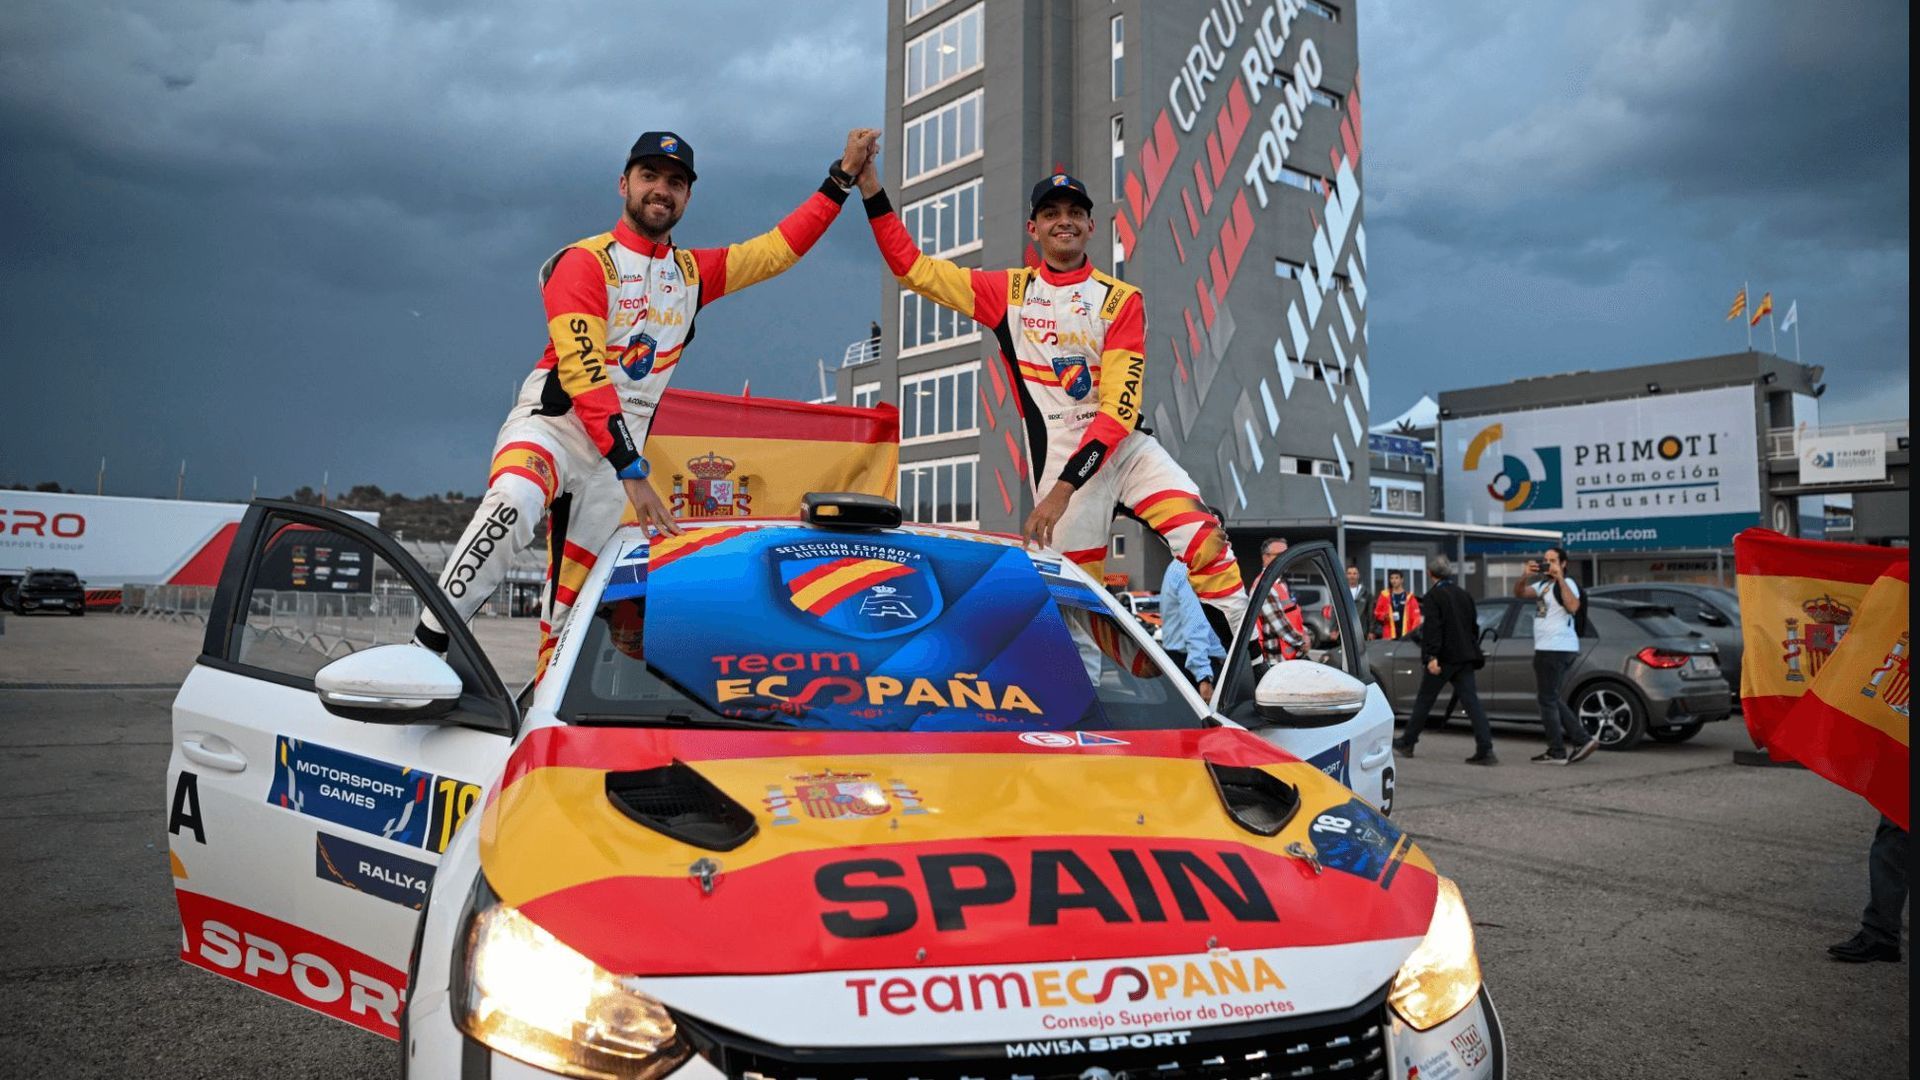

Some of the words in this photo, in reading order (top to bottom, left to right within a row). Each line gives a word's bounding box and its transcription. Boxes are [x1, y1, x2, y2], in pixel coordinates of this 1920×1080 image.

[1244, 38, 1323, 208] TORMO
[570, 318, 606, 384] SPAIN
[1118, 356, 1144, 420] SPAIN
[1575, 433, 1718, 466] PRIMOTI
[1576, 465, 1719, 486] automoción
[1576, 487, 1720, 509] industrial
[444, 502, 518, 599] sparco
[775, 542, 848, 554] SELECCIÓN
[854, 544, 921, 560] ESPAÑOLA
[795, 549, 908, 563] AUTOMOVILISMO
[296, 759, 405, 799] MOTORSPORT
[319, 784, 376, 810] GAMES
[1312, 814, 1352, 835] 18
[358, 860, 427, 894] RALLY4
[814, 848, 1281, 939] SPAIN
[1042, 1011, 1115, 1031] Consejo
[1119, 1006, 1192, 1027] Superior
[1196, 1003, 1218, 1020] de
[1221, 999, 1295, 1020] Deportes
[1005, 1039, 1087, 1059] MAVISA
[1088, 1031, 1191, 1052] SPORT
